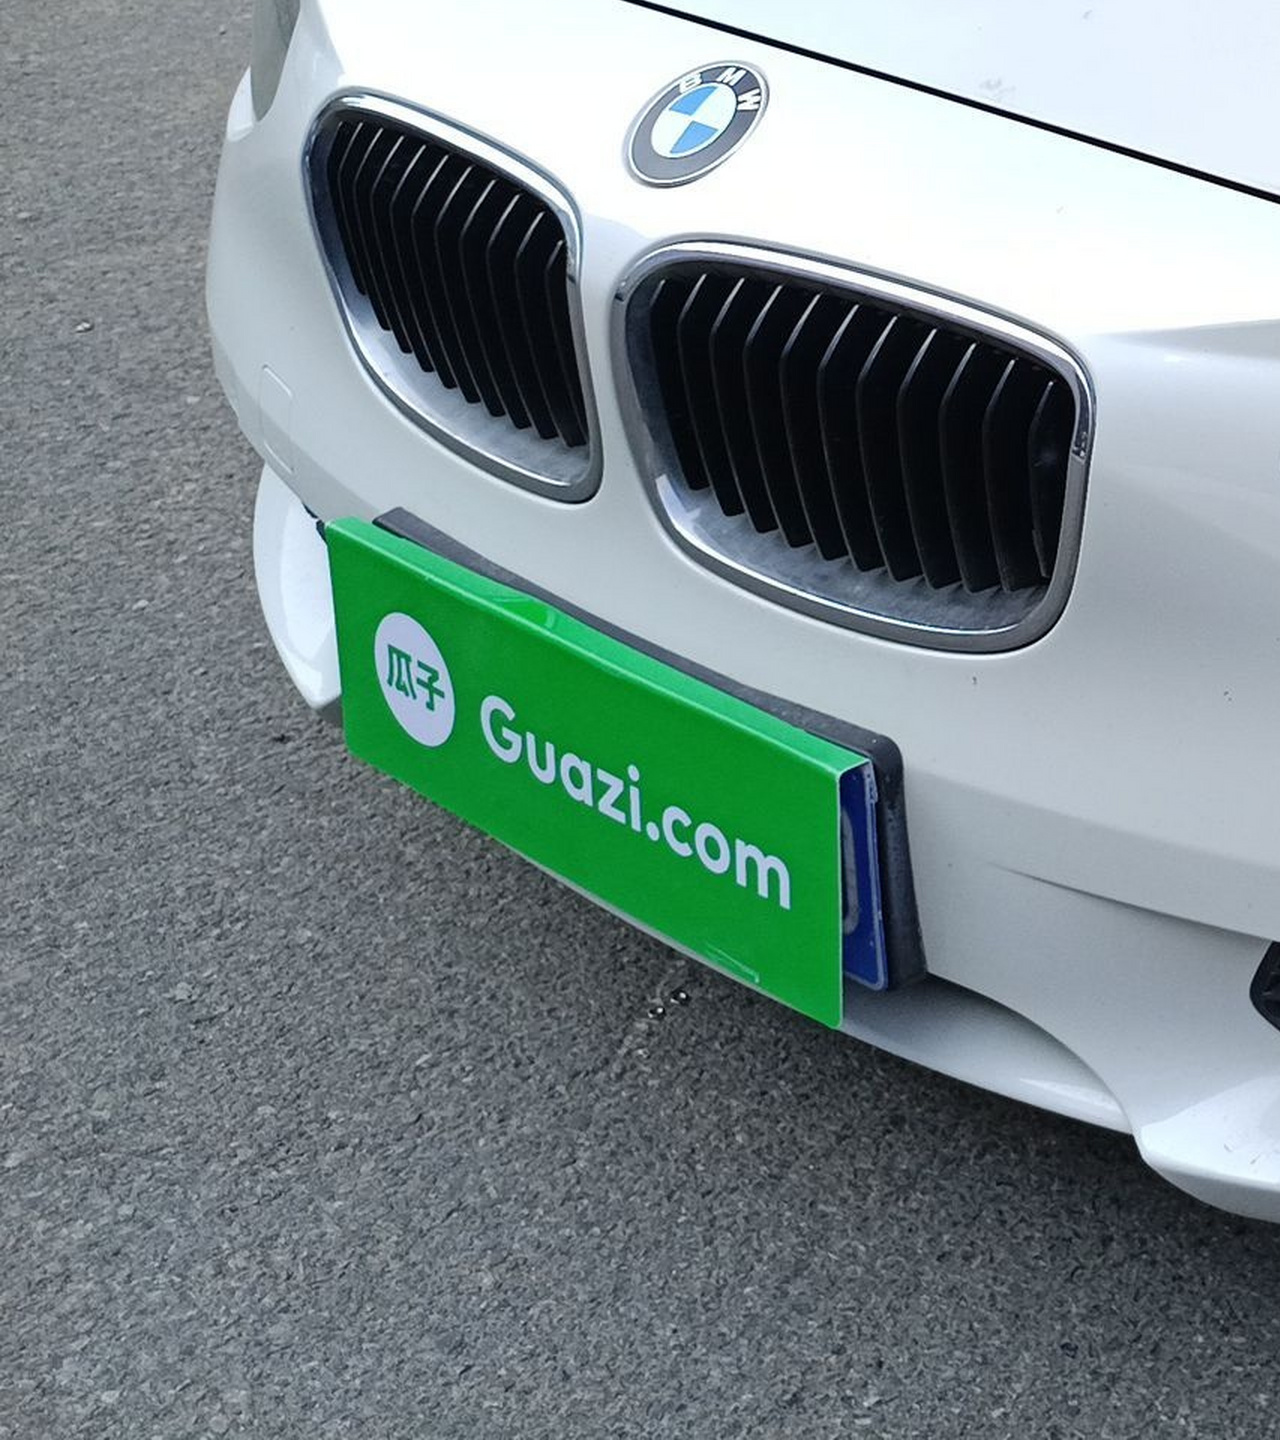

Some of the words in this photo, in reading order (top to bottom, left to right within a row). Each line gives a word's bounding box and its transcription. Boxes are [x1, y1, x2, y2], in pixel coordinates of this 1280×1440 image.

[678, 67, 762, 112] BMW
[386, 645, 446, 712] 瓜子
[480, 695, 792, 910] Guazi.com
